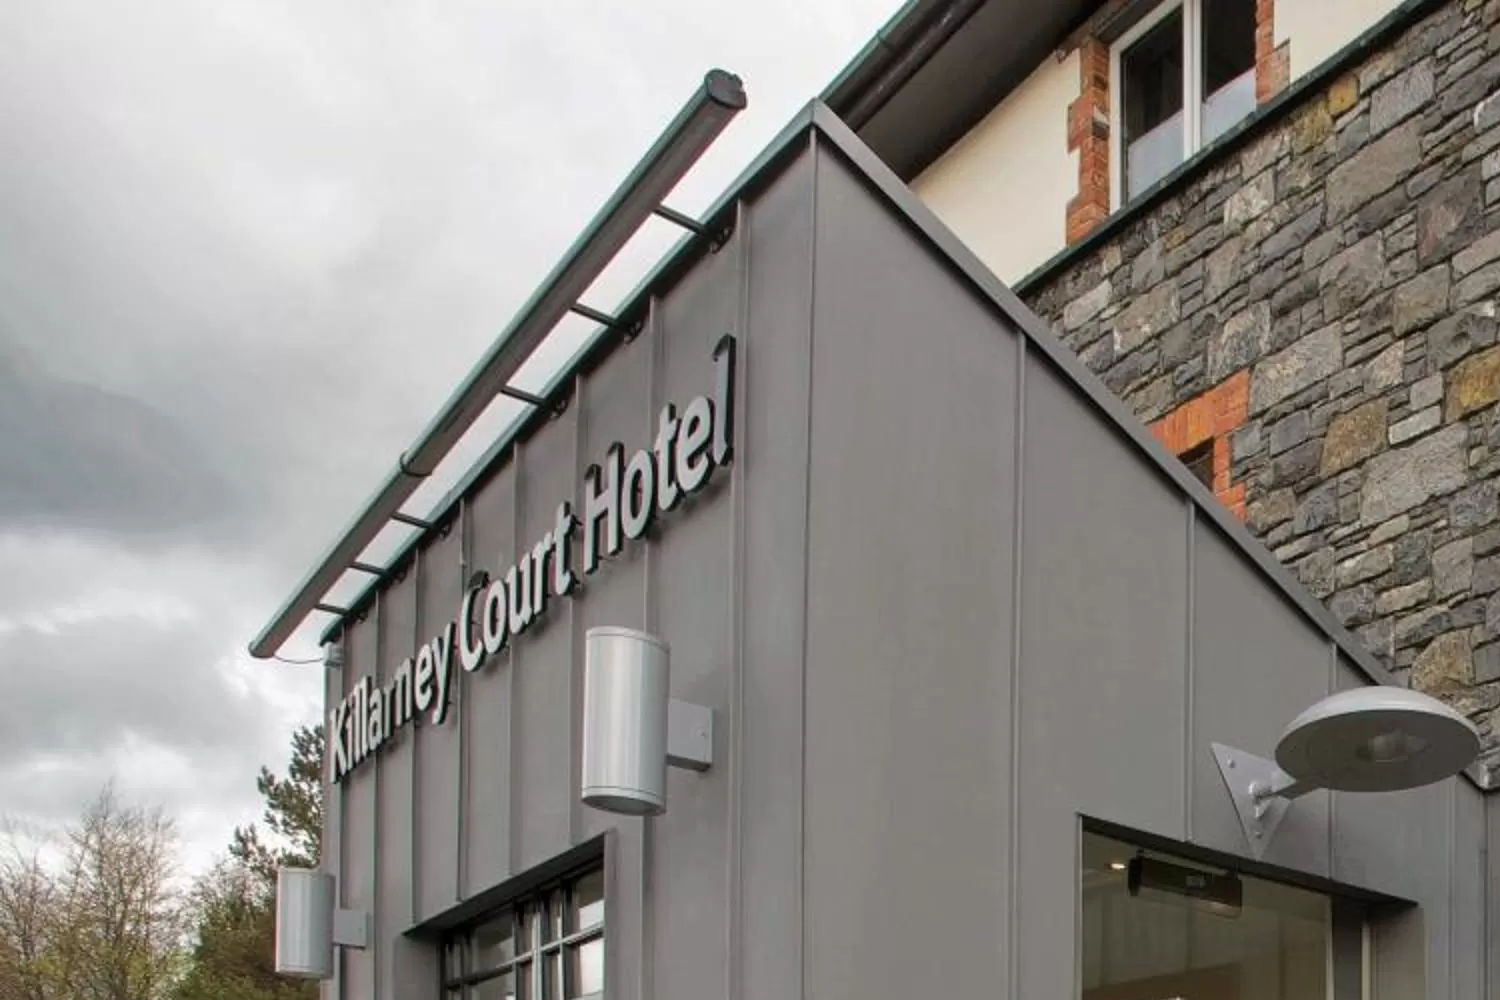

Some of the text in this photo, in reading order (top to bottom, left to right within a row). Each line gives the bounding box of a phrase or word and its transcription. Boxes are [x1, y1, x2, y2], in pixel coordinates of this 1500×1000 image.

[329, 335, 736, 784] Killarney Court Hotel
